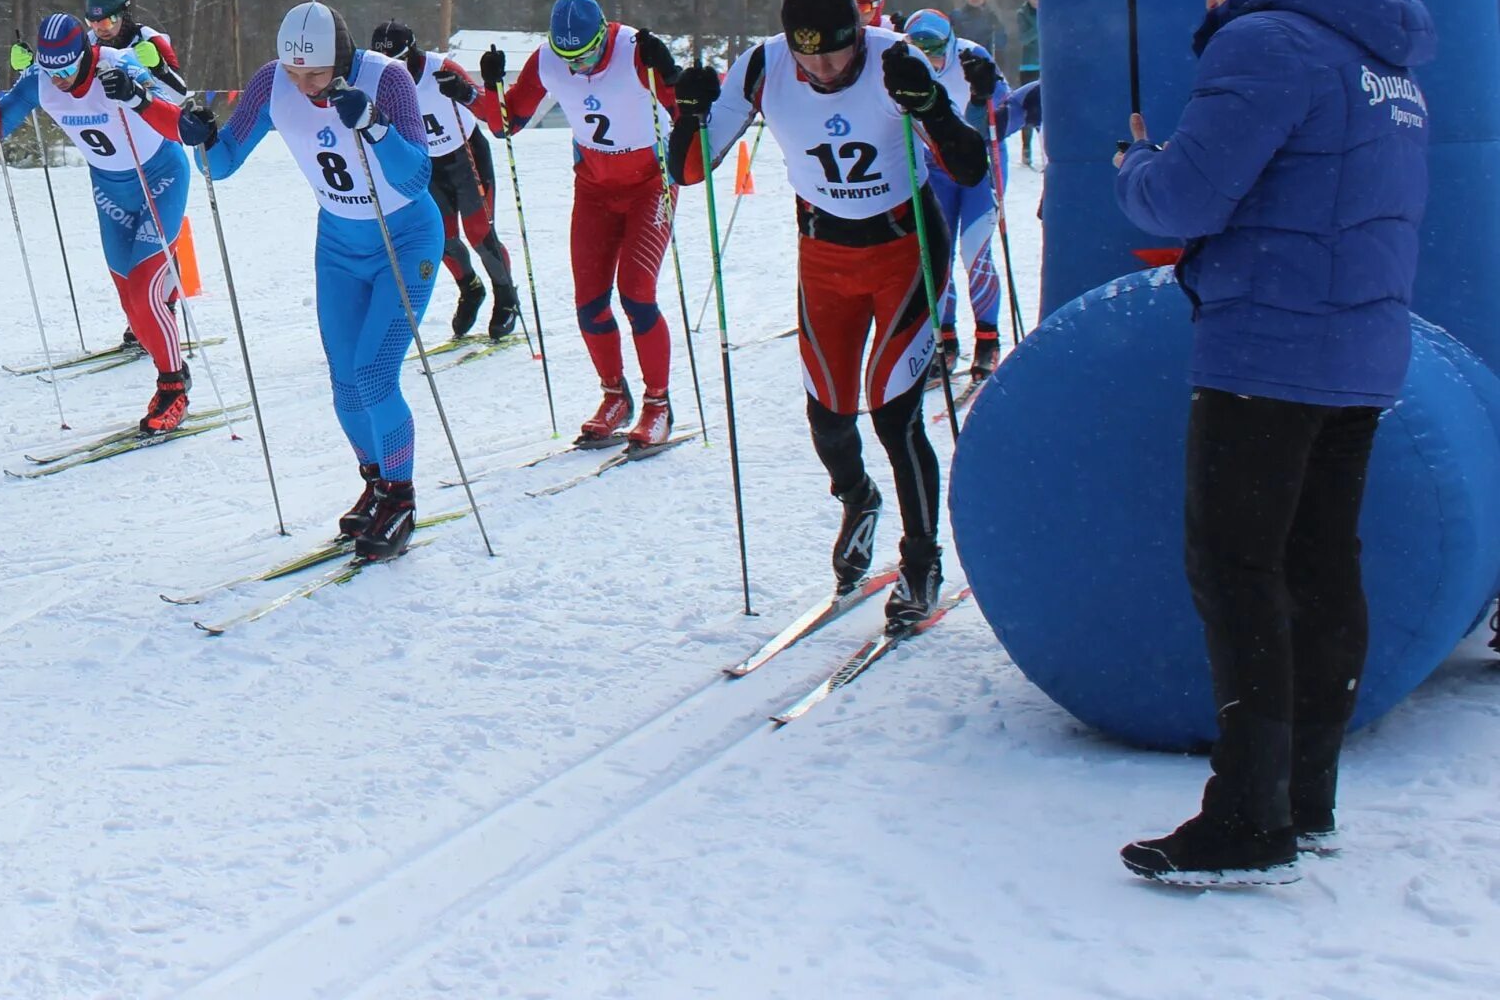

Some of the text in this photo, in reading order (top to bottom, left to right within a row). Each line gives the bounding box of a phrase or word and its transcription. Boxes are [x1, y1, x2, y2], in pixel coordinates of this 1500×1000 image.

[285, 36, 314, 55] DNB
[556, 34, 581, 47] DNB
[61, 113, 109, 126] ДИНАМО
[584, 114, 614, 146] 2
[80, 129, 116, 156] 9
[316, 151, 354, 192] 8
[806, 142, 882, 183] 12
